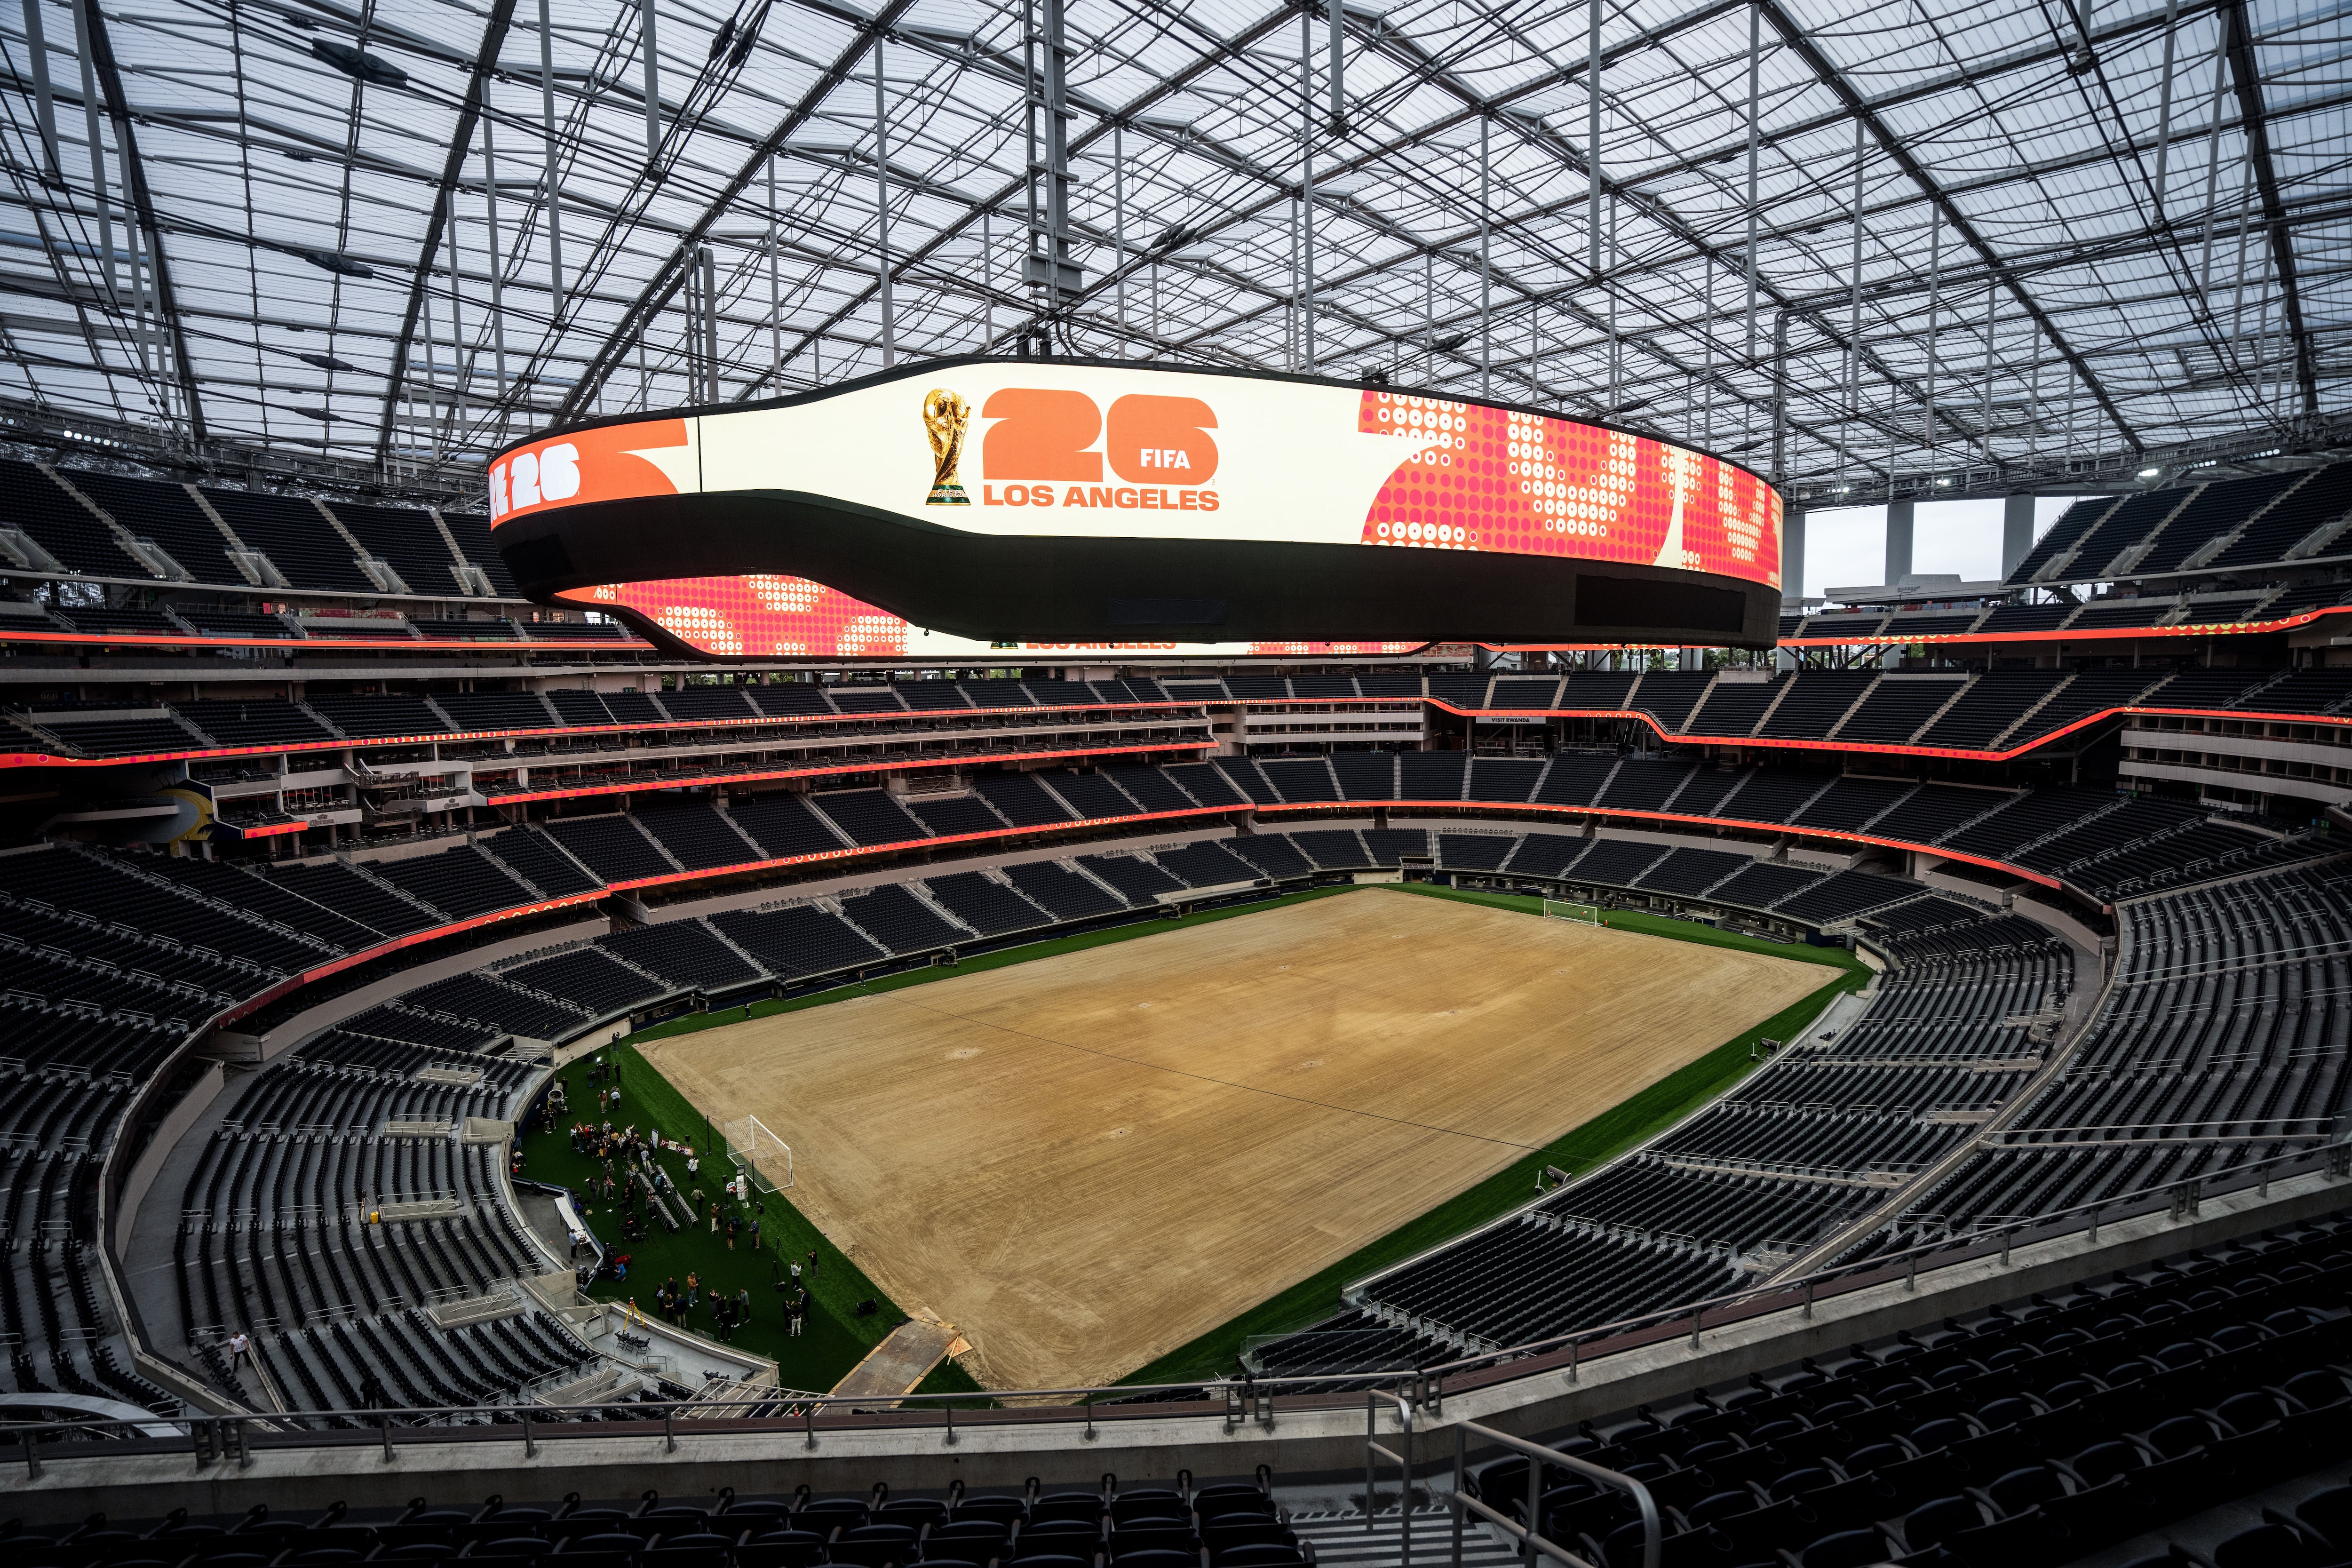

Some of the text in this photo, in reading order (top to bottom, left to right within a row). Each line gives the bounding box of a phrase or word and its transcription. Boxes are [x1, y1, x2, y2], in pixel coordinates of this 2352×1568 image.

[982, 388, 1218, 486] 26
[1141, 449, 1191, 469] FIFA
[511, 443, 580, 511] 26
[984, 485, 1219, 511] LOS ANGELES
[1546, 1170, 1555, 1178] SGL
